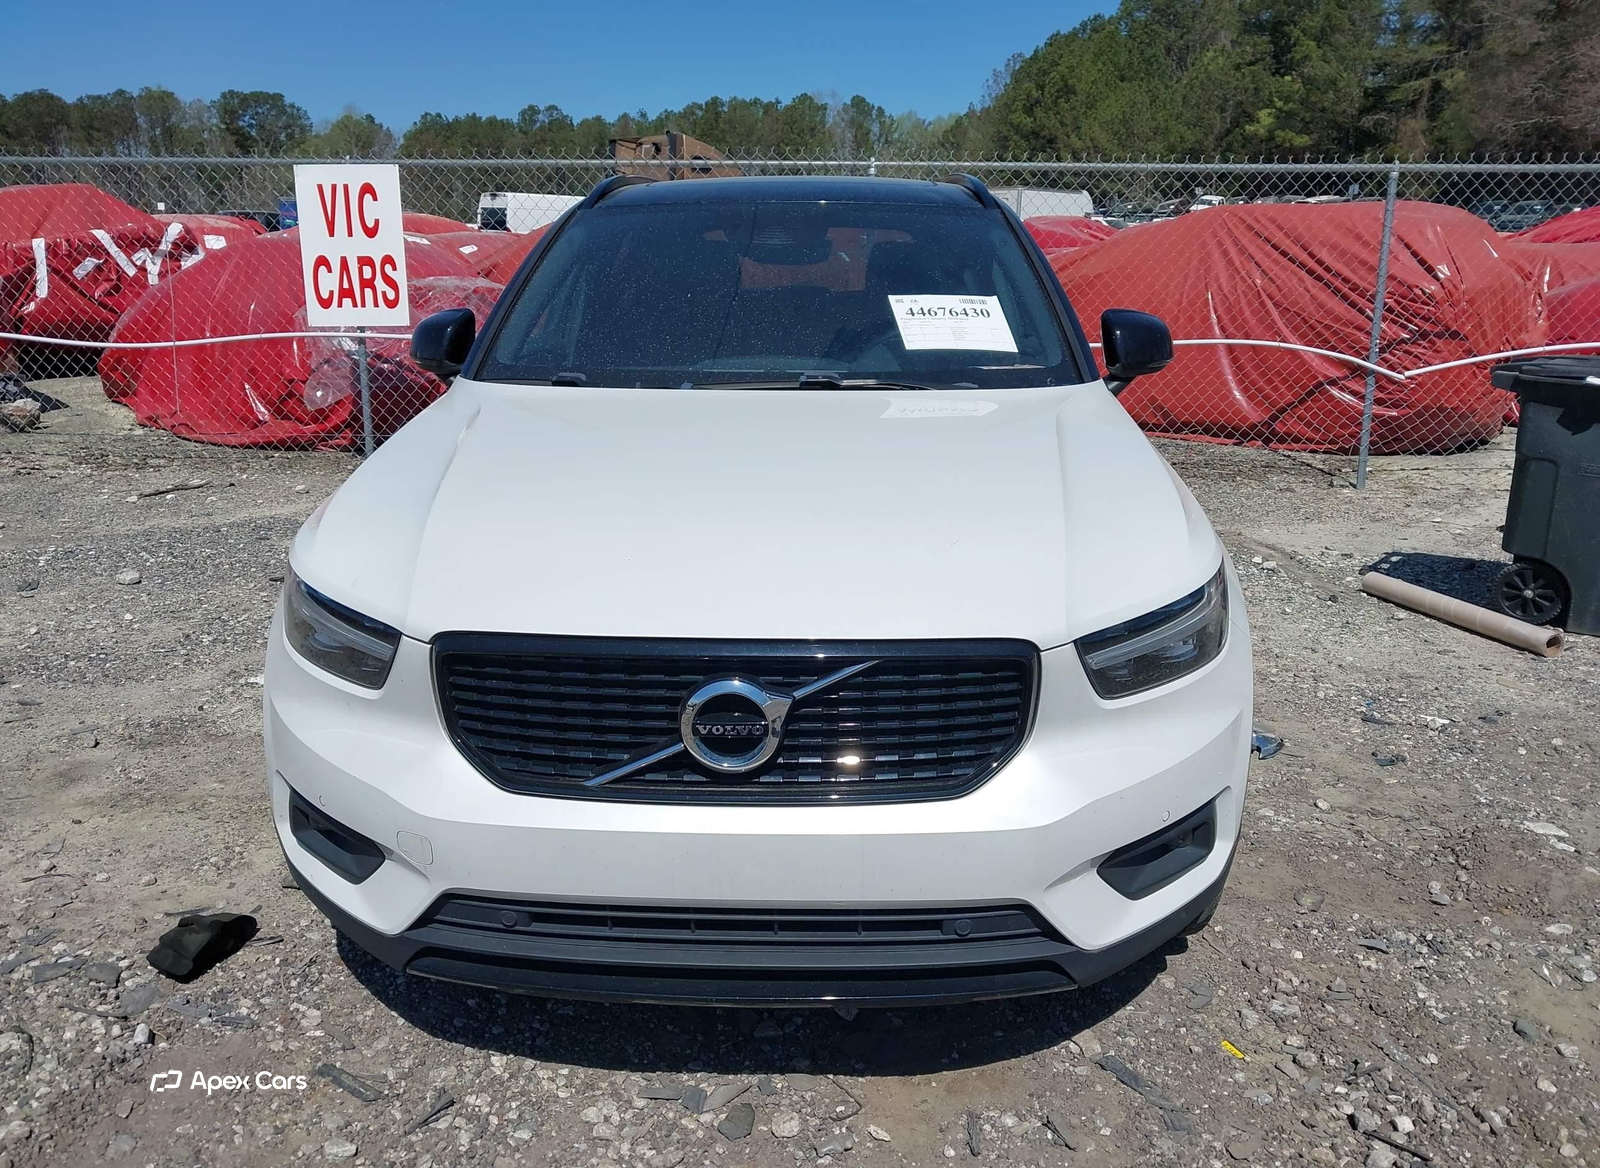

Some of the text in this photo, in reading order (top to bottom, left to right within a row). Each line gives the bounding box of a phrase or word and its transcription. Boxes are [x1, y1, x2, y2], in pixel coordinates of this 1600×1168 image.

[316, 181, 380, 239] VIC
[312, 254, 400, 310] CARS
[905, 306, 991, 318] 44676430
[695, 724, 765, 736] VOLVO
